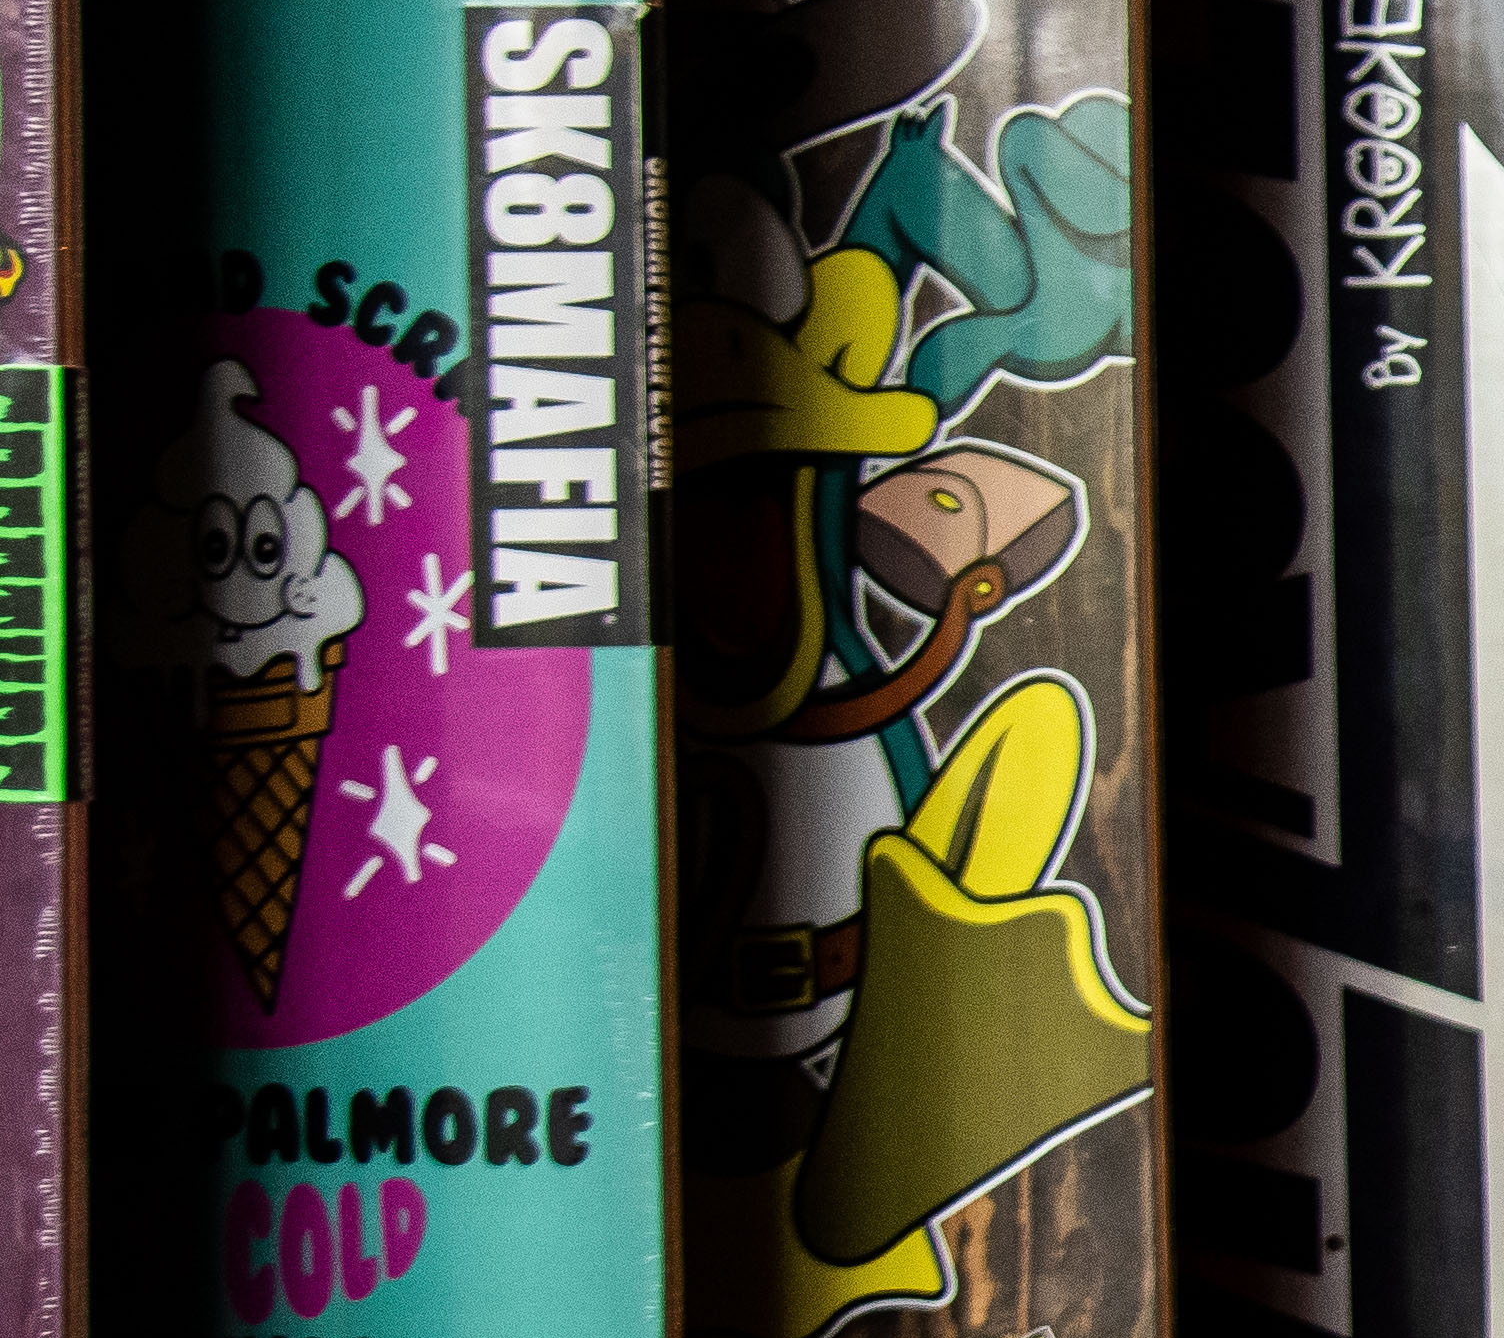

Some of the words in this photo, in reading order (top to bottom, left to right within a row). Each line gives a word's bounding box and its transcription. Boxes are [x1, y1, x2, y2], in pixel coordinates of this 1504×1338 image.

[308, 259, 467, 403] SCR
[483, 17, 620, 630] SK8MAFIA
[199, 1083, 593, 1166] PALMORE
[222, 1176, 428, 1326] COLD
